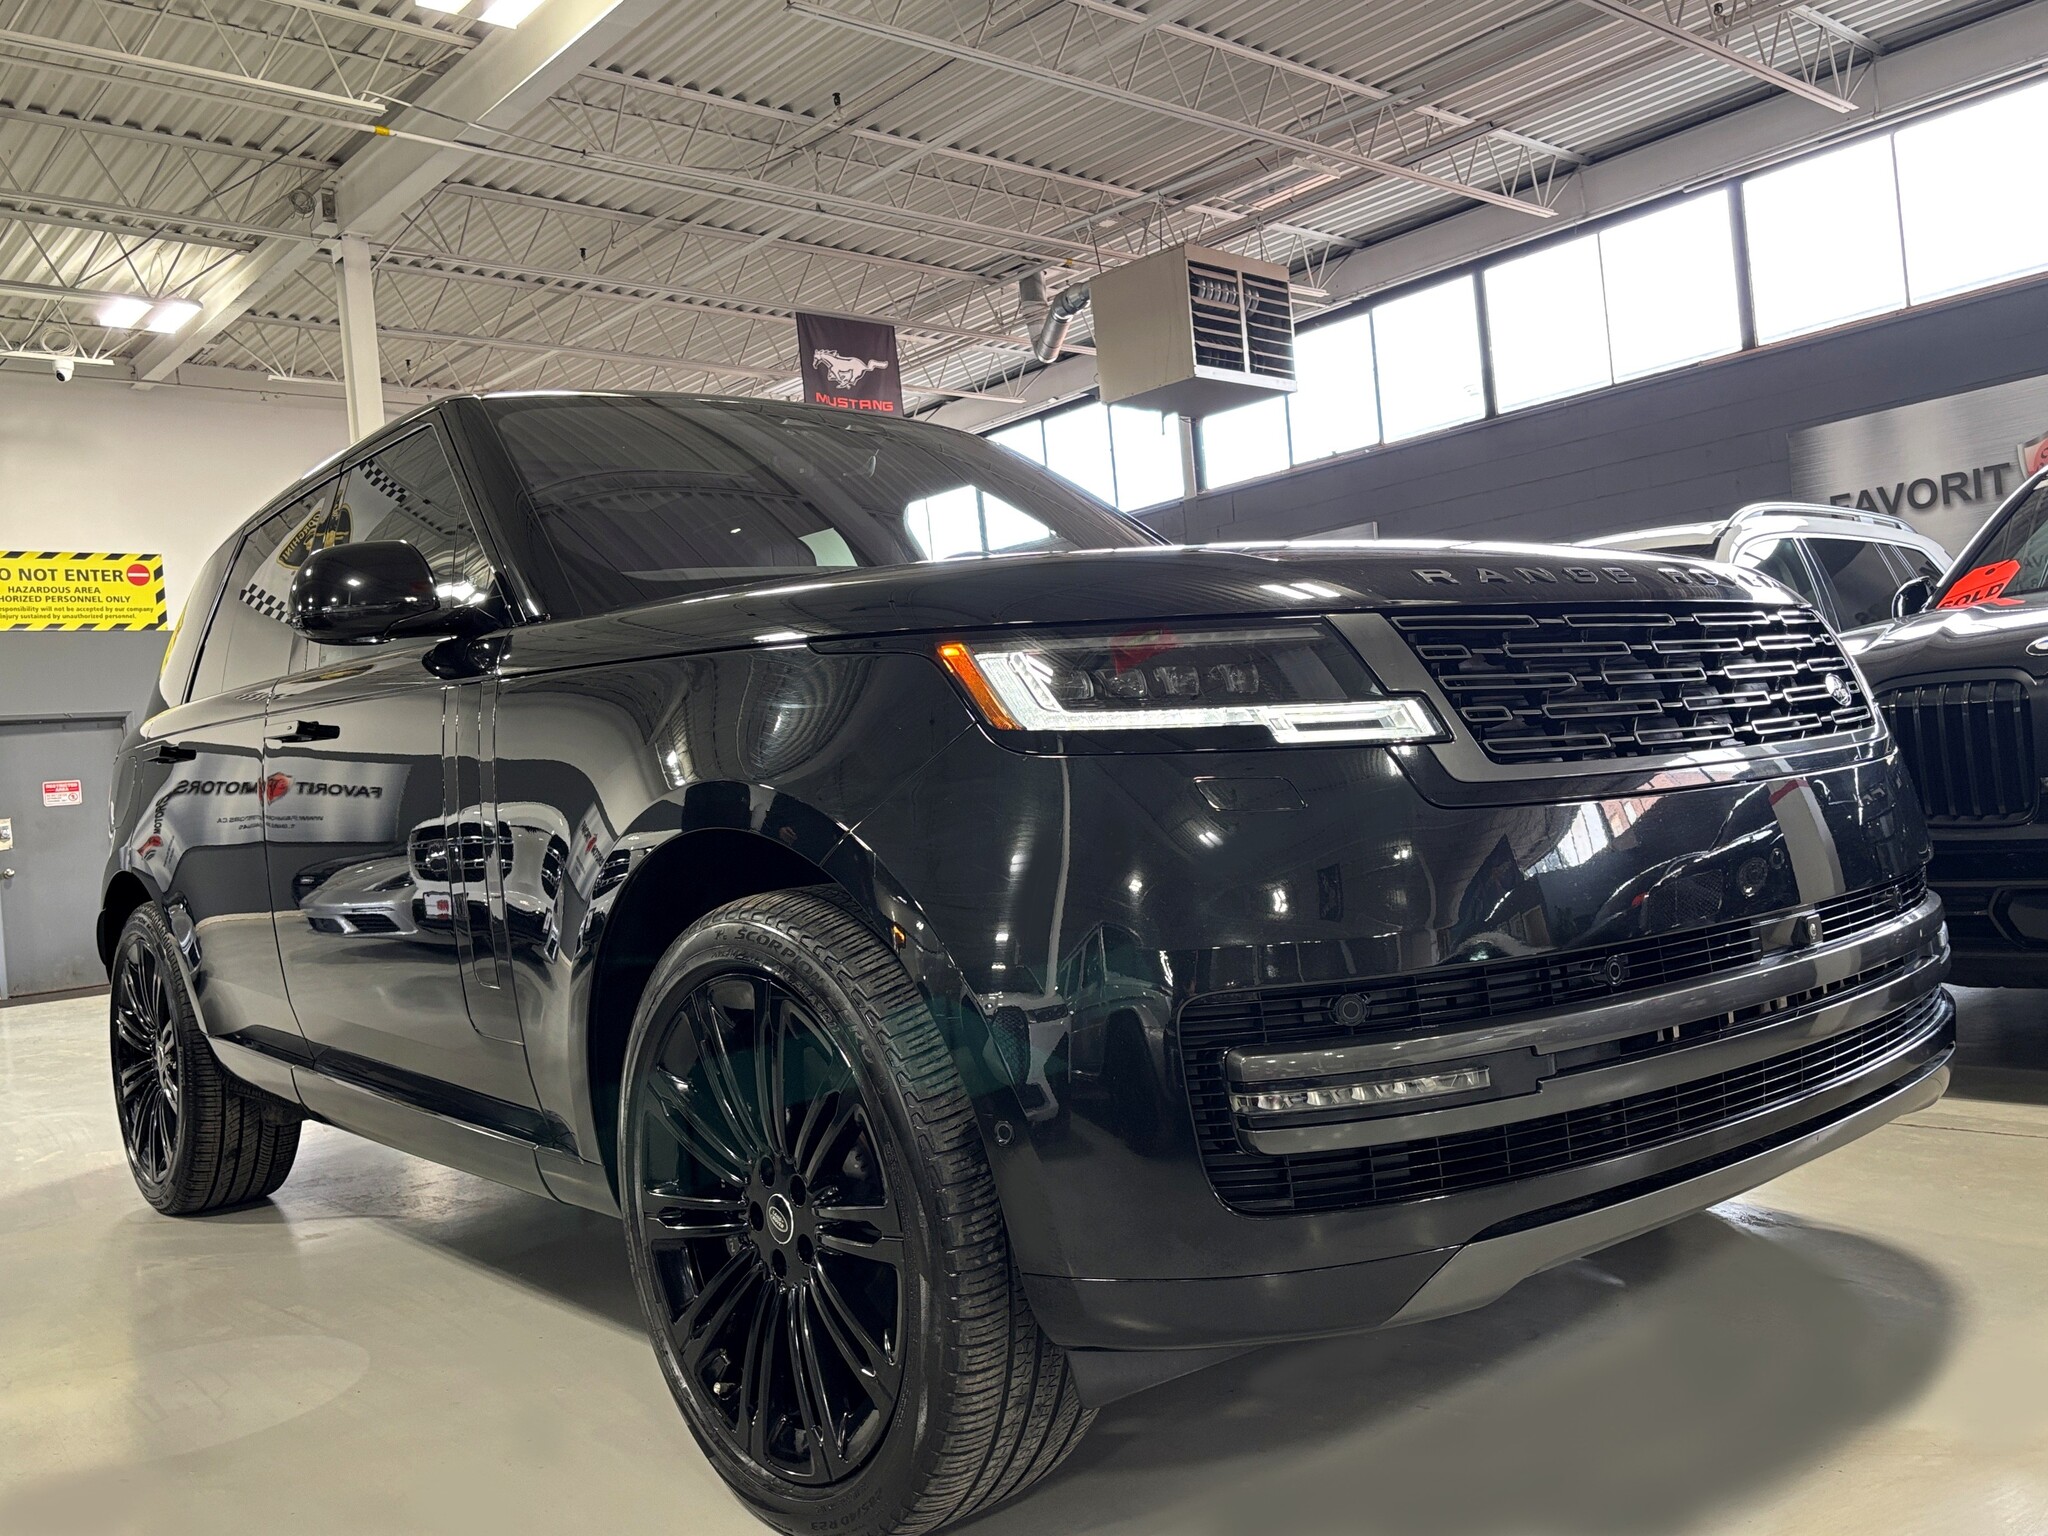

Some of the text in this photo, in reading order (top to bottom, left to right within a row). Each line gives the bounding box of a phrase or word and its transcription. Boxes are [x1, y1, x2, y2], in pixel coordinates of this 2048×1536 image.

[815, 392, 894, 412] MUSTANG
[1829, 462, 2011, 518] FAVORIT
[19, 568, 58, 581] NOT
[65, 569, 124, 582] ENTER
[1411, 566, 1638, 586] RANGE
[8, 586, 101, 594] HAZARDOUS AREA
[45, 595, 103, 603] PERSONNEL
[734, 926, 825, 987] SCORPION
